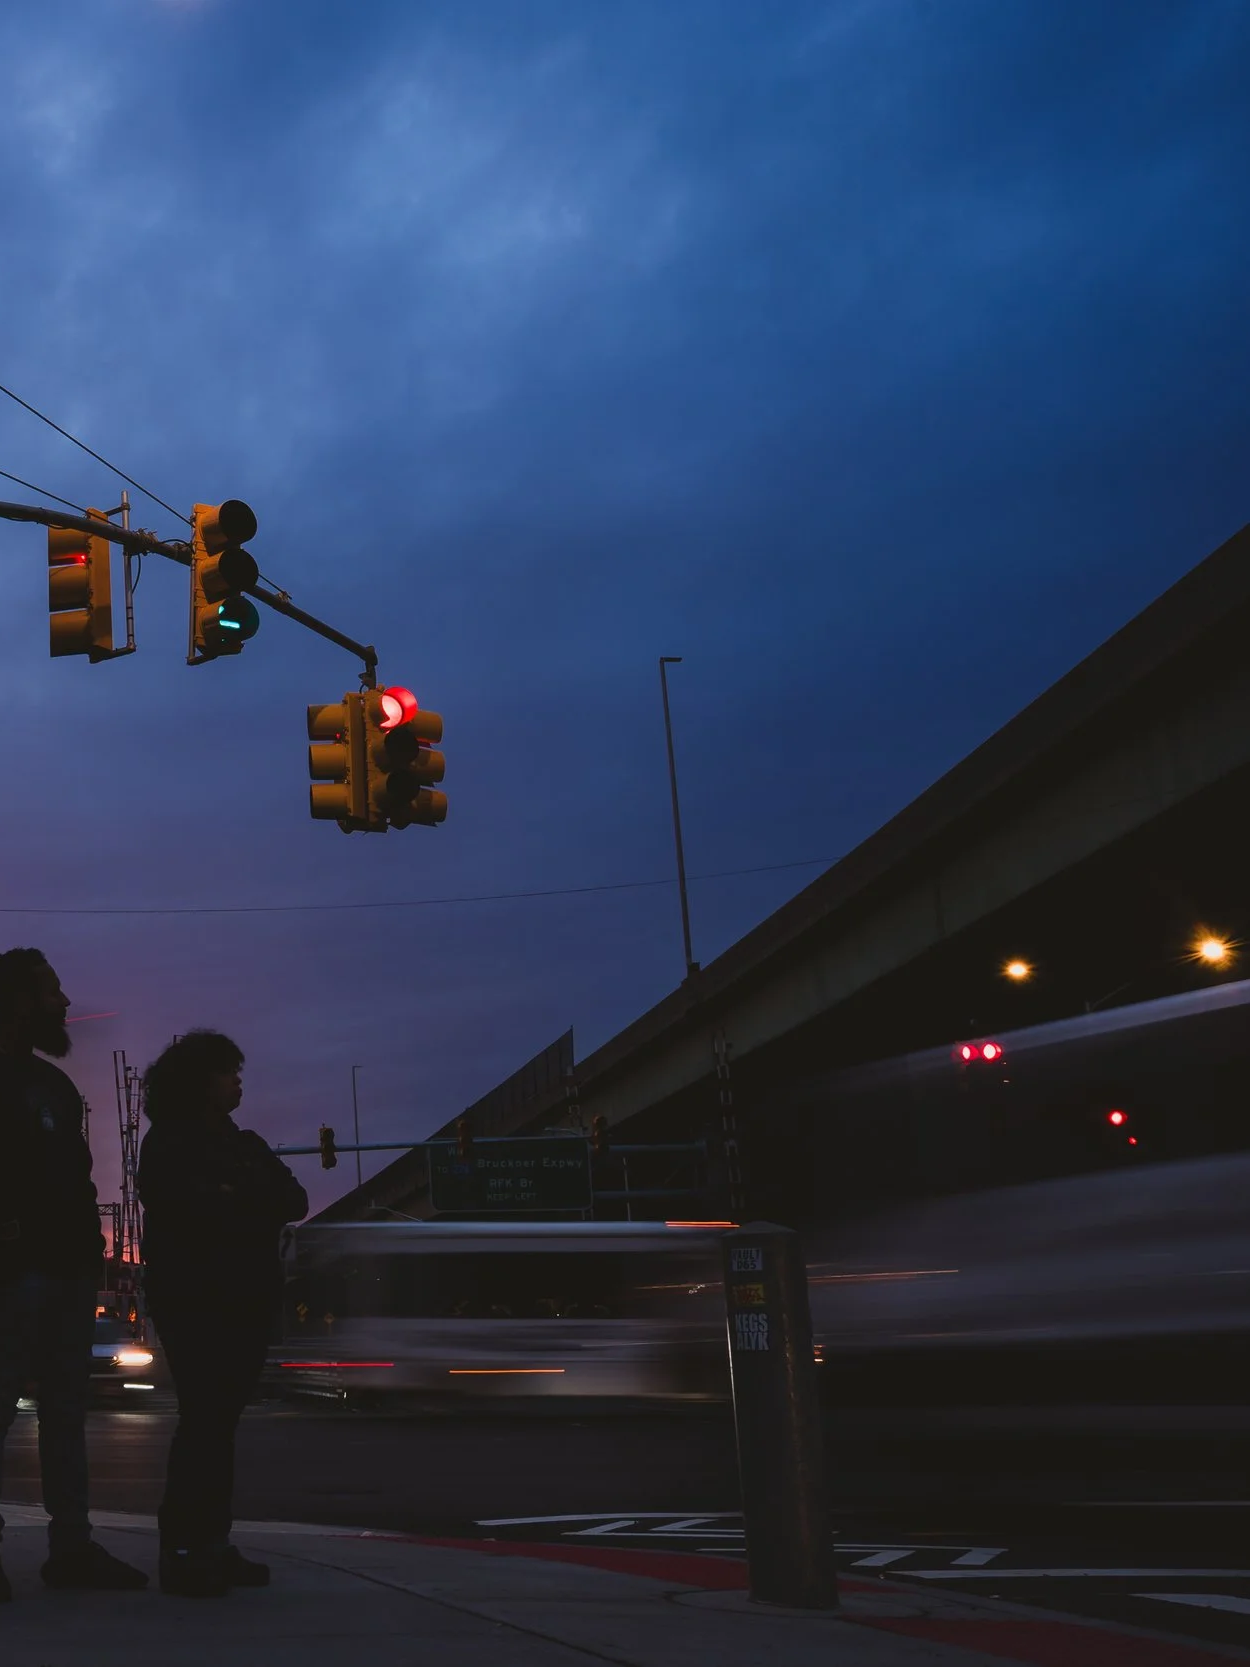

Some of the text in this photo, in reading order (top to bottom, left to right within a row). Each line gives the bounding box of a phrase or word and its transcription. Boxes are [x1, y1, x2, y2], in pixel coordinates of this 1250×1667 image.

[542, 1156, 584, 1170] Expwy
[489, 1177, 534, 1189] RFK Br
